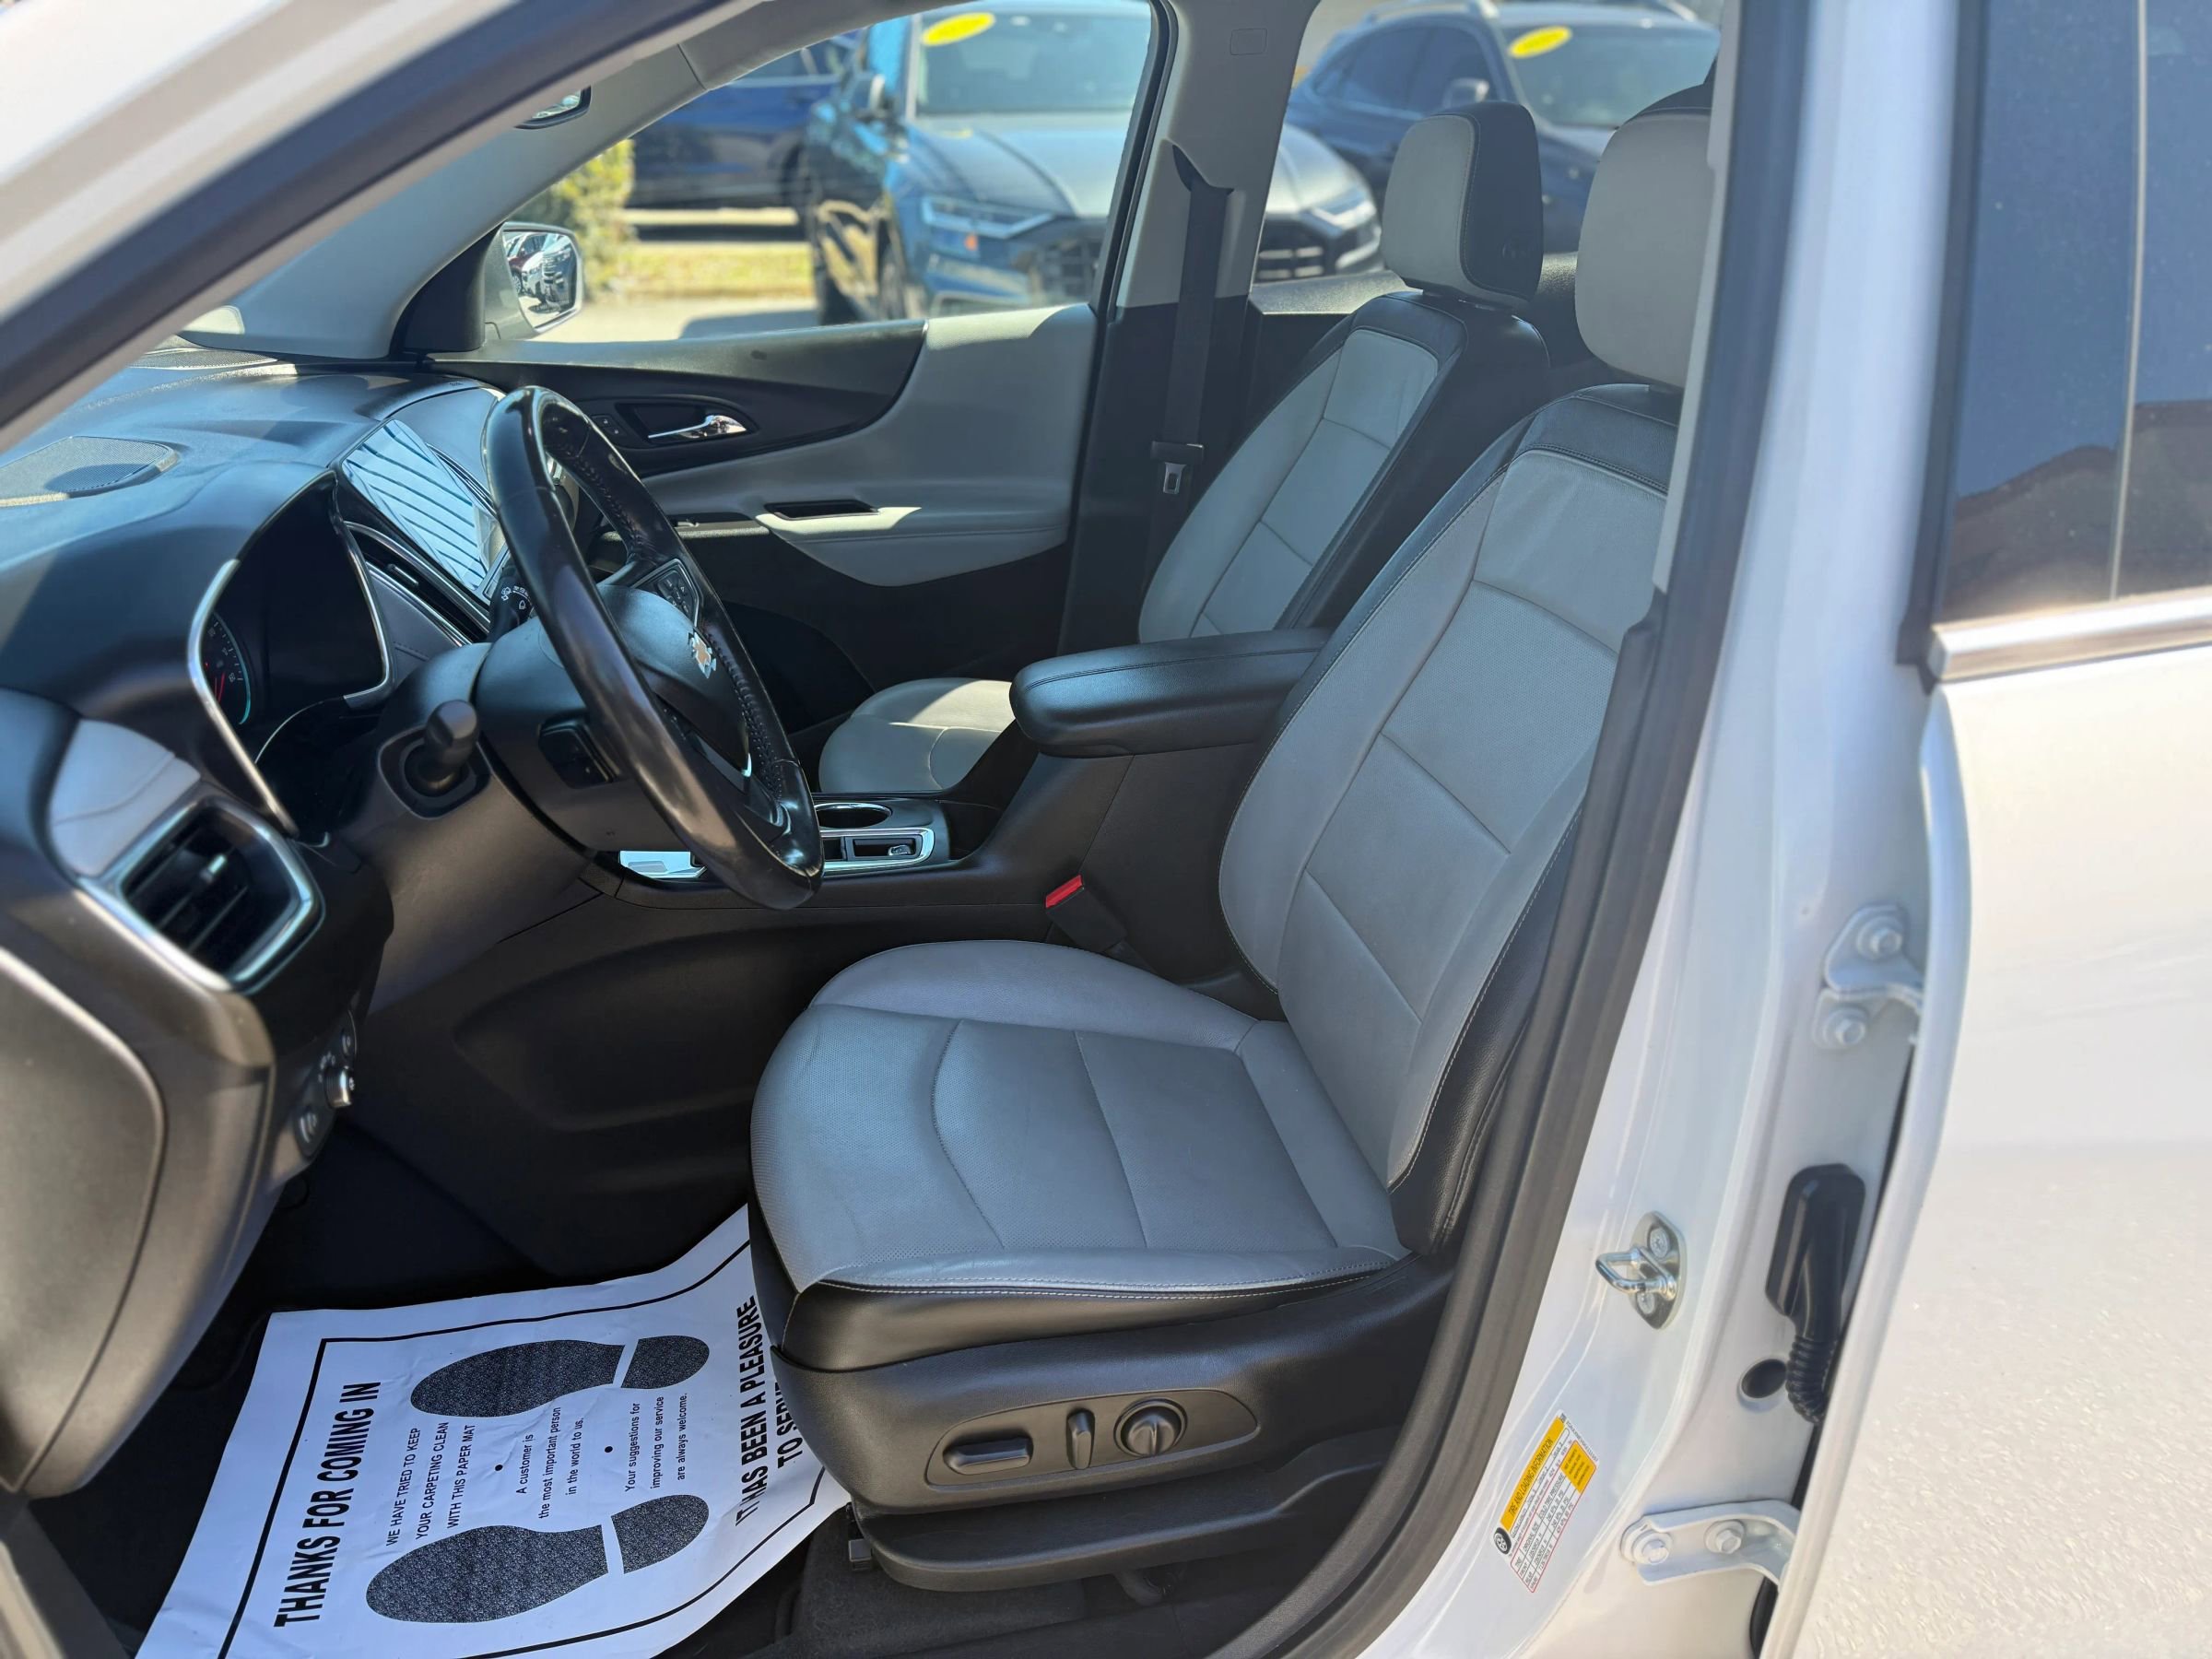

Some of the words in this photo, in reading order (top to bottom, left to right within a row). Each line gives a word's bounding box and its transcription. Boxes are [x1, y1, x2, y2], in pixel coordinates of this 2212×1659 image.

[736, 1295, 766, 1393] PLEASURE
[339, 1382, 381, 1403] IN
[740, 1391, 767, 1408] A
[550, 1407, 561, 1433] person
[630, 1403, 641, 1415] for
[653, 1396, 665, 1425] service
[677, 1393, 688, 1432] welcome.
[433, 1422, 449, 1452] CLEAN
[463, 1425, 476, 1442] MAT
[571, 1431, 582, 1441] to
[575, 1418, 584, 1430] us.
[654, 1428, 663, 1441] our
[317, 1408, 374, 1481] COMING
[406, 1428, 420, 1452] KEEP
[523, 1434, 534, 1442] is
[629, 1417, 640, 1467] suggestions
[676, 1433, 688, 1464] always
[740, 1410, 768, 1465] BEEN
[404, 1453, 416, 1467] TO
[456, 1444, 471, 1476] PAPER
[519, 1444, 532, 1485] customer
[543, 1435, 558, 1476] important
[571, 1442, 581, 1466] world
[650, 1443, 665, 1488] improving
[777, 1437, 803, 1468] TO
[397, 1469, 412, 1497] TRIED
[422, 1454, 442, 1509] CARPETING
[567, 1469, 578, 1484] the
[625, 1470, 636, 1492] Your
[677, 1465, 686, 1480] are
[740, 1465, 769, 1506] HAS
[1508, 1503, 1517, 1515] TIRE
[1513, 1491, 1523, 1505] AND
[1518, 1469, 1535, 1495] LOADING
[1530, 1437, 1553, 1472] INFORMATION
[452, 1479, 465, 1500] THIS
[543, 1477, 553, 1501] most
[565, 1486, 577, 1495] in
[302, 1488, 354, 1528] FOR
[391, 1499, 406, 1526] HAVE
[447, 1502, 461, 1528] WITH
[538, 1503, 550, 1519] the
[735, 1500, 760, 1526] IT
[386, 1529, 400, 1546] WE
[416, 1512, 432, 1539] YOUR
[274, 1535, 340, 1627] THANKS
